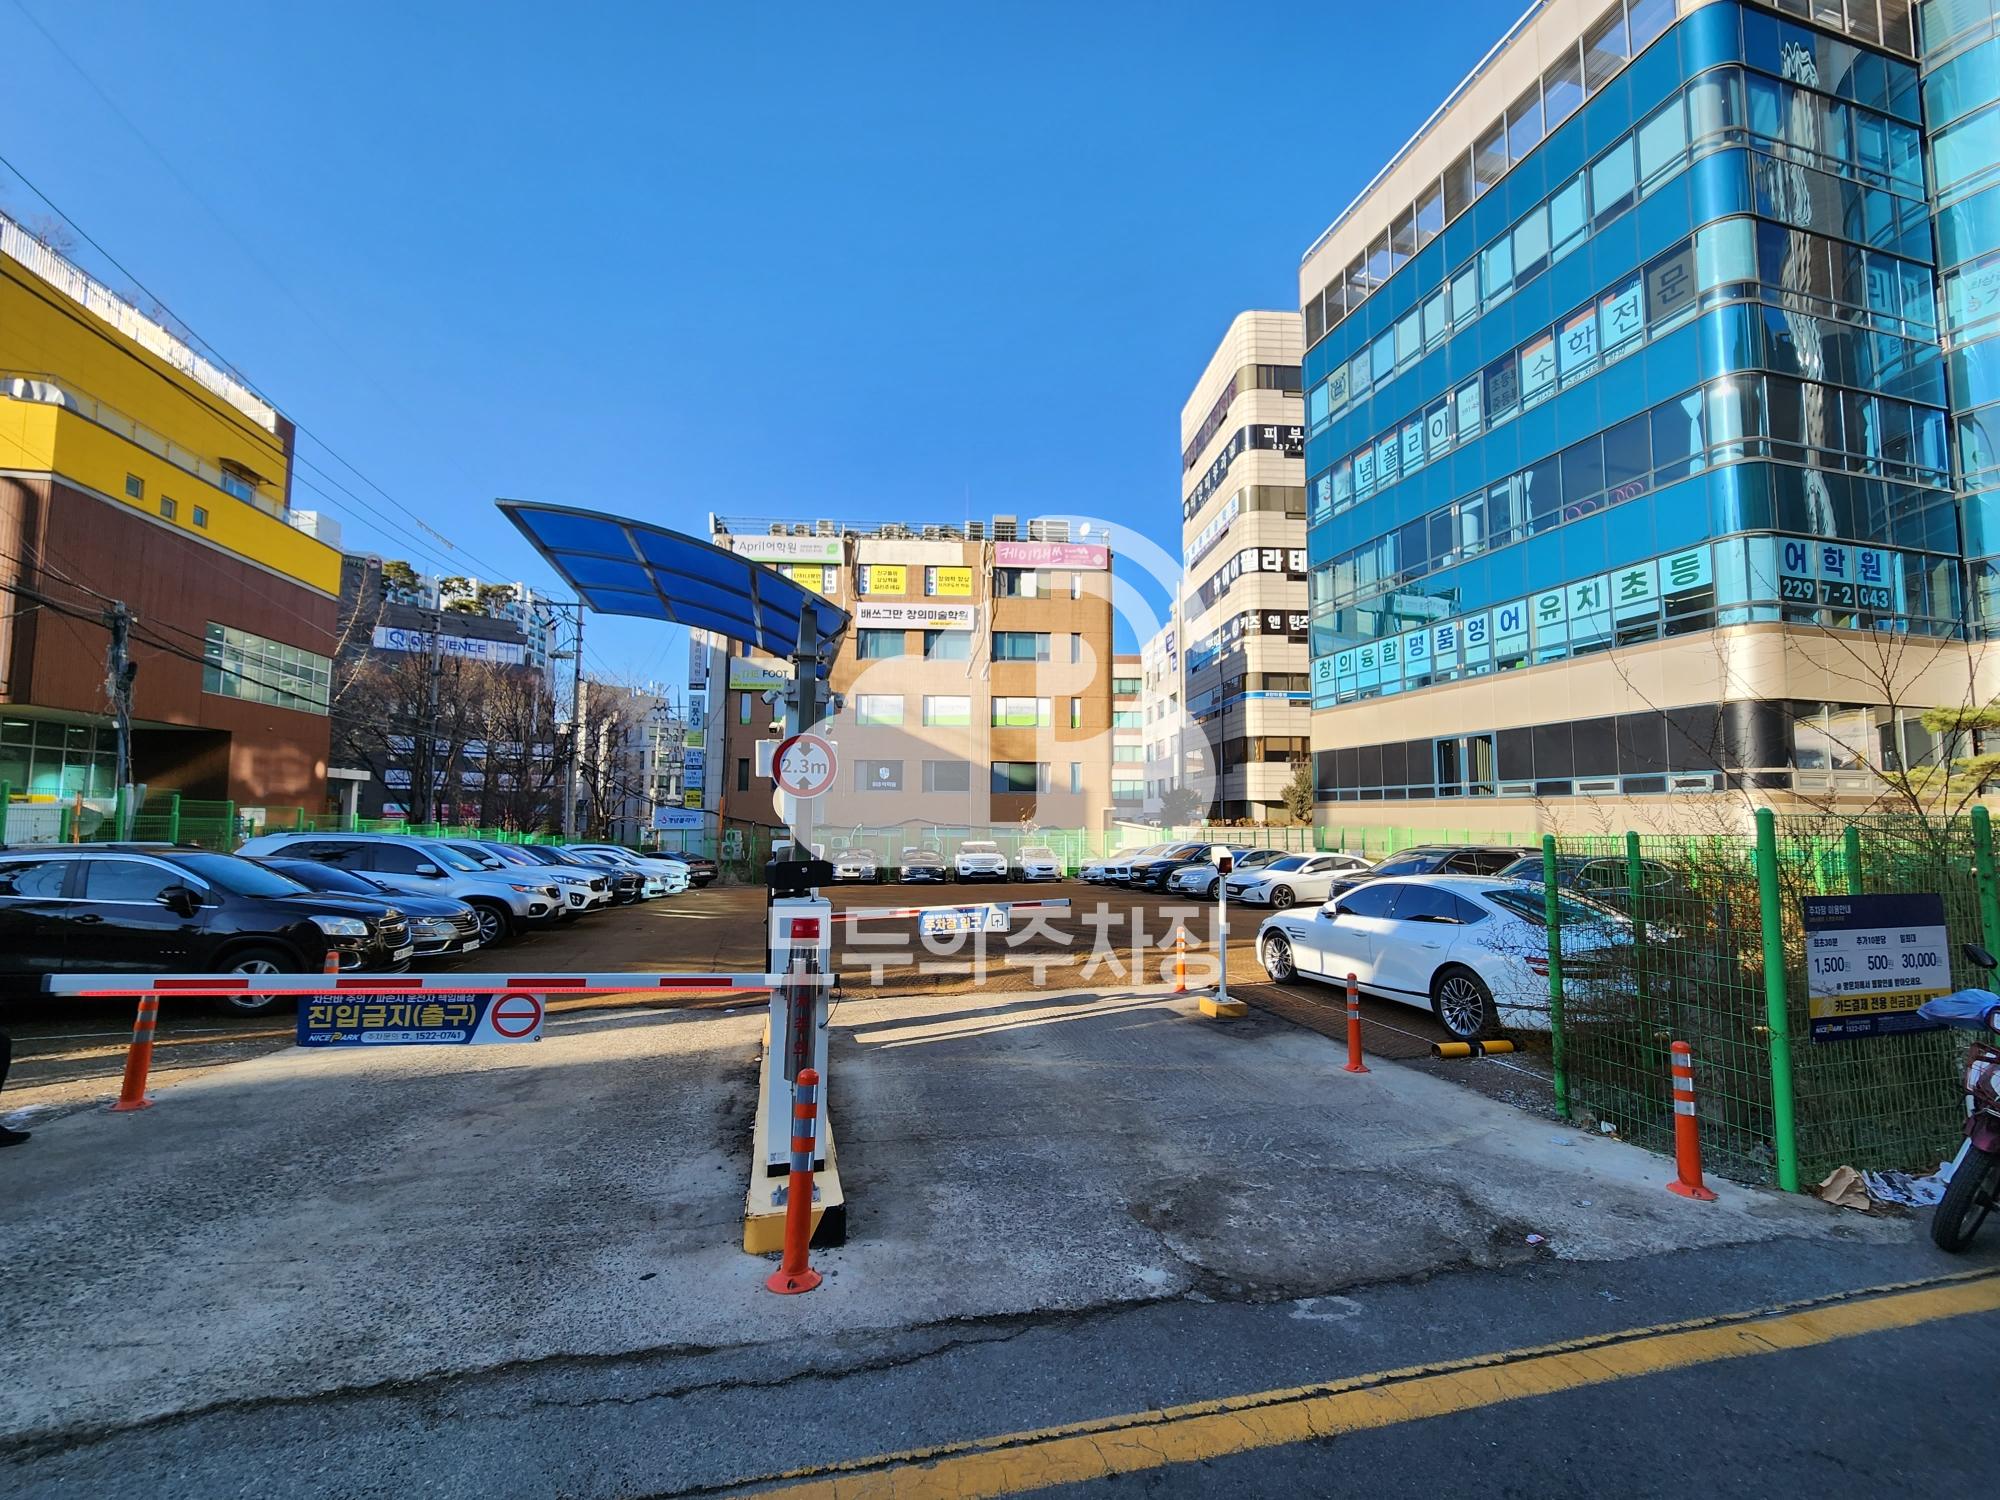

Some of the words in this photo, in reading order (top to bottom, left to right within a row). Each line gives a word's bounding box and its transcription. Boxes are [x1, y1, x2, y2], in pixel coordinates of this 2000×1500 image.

[1784, 542, 1882, 582] 어학원
[1538, 553, 1702, 622] 유치초등
[1782, 579, 1889, 608] 2297-2043
[1409, 606, 1521, 658] 명품영어
[1319, 640, 1399, 679] 창의융합
[762, 669, 789, 679] FOOT
[781, 757, 828, 775] 2.3m
[308, 1003, 476, 1029] 진입금지(출구)
[309, 1031, 362, 1043] NICEPARK
[415, 1031, 461, 1041] 1522-0741
